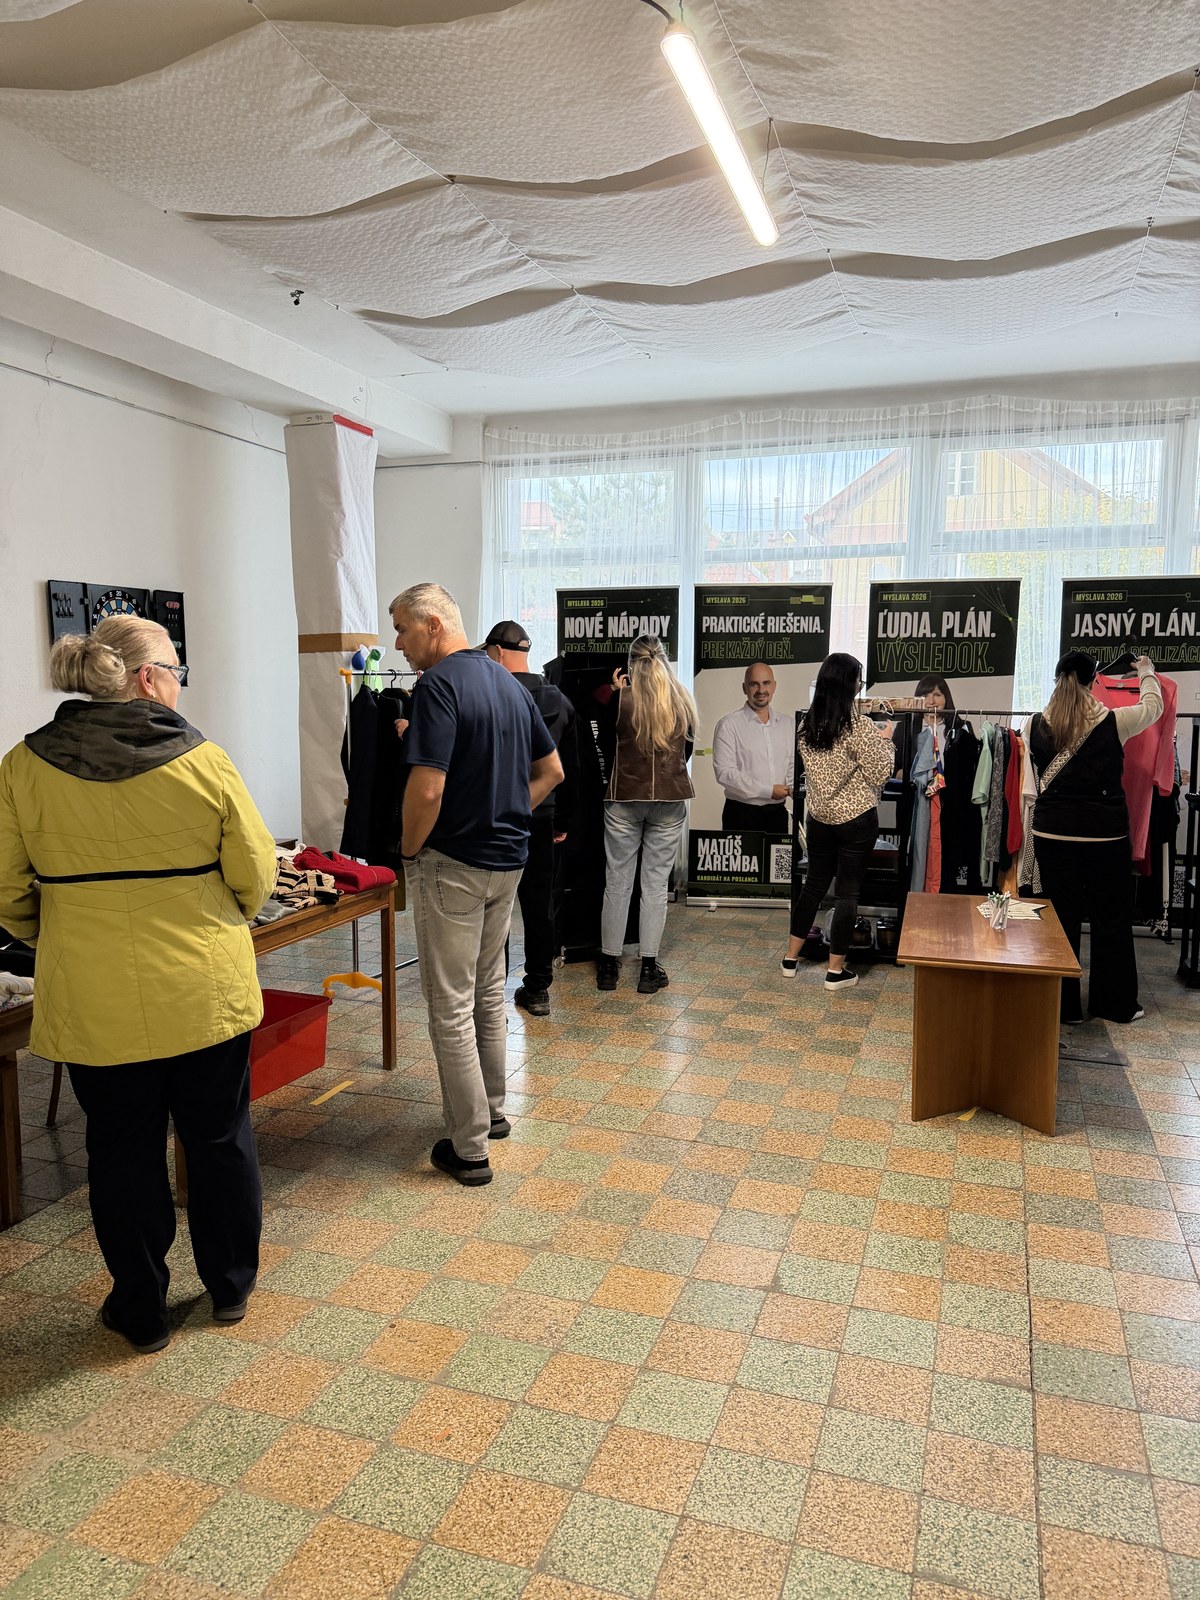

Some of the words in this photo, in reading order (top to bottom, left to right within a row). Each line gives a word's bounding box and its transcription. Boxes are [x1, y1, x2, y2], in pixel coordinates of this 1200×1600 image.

[882, 593, 910, 601] MYSLAVA
[911, 593, 927, 601] 2026
[1076, 593, 1105, 601] MYSLAVA
[564, 611, 604, 638] NOVÉ
[607, 611, 671, 638] NÁPADY
[702, 612, 765, 633] PRAKTICKÉ
[767, 612, 825, 633] RIEŠENIA.
[877, 609, 937, 639] ĽUDIA.
[941, 606, 997, 638] PLÁN.
[1070, 608, 1137, 638] JASNÝ
[1141, 607, 1200, 637] PLÁN.
[701, 640, 725, 659] PRE
[725, 637, 766, 659] KAŽDÝ
[766, 637, 794, 659] DEŇ.
[876, 636, 995, 673] VÝSLEDOK.
[697, 835, 743, 857] MATÚŠ
[697, 854, 760, 873] ZAREMBA
